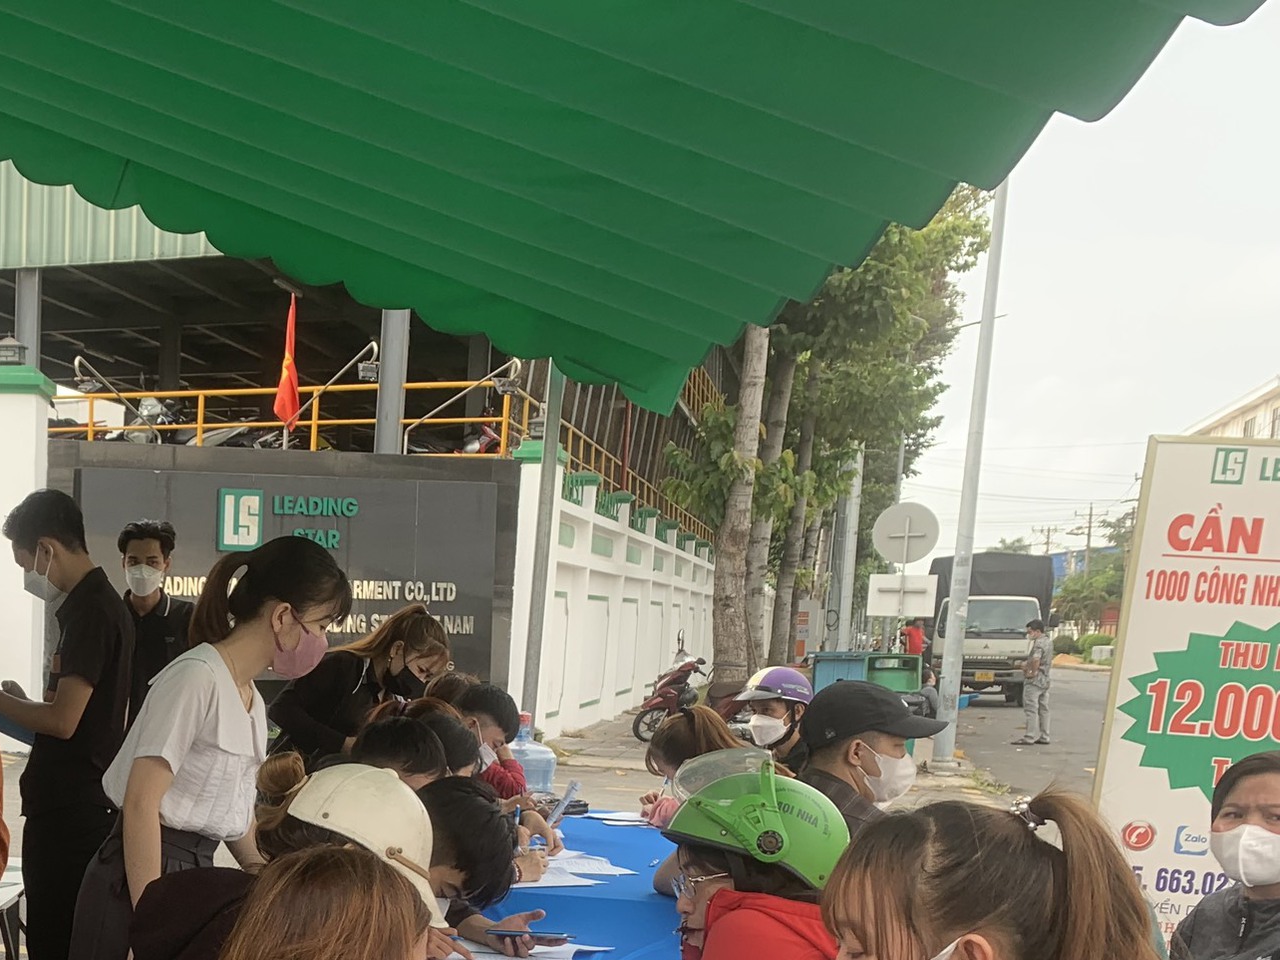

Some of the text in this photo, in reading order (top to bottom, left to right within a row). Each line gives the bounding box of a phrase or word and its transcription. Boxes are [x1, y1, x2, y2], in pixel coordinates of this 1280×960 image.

[1211, 448, 1248, 484] LS
[222, 493, 359, 547] LS LEADING
[1167, 502, 1265, 555] CẦN
[1145, 569, 1191, 602] 1000
[1194, 565, 1249, 606] CÔNG
[1220, 641, 1269, 670] THU
[1184, 833, 1208, 844] Zalo
